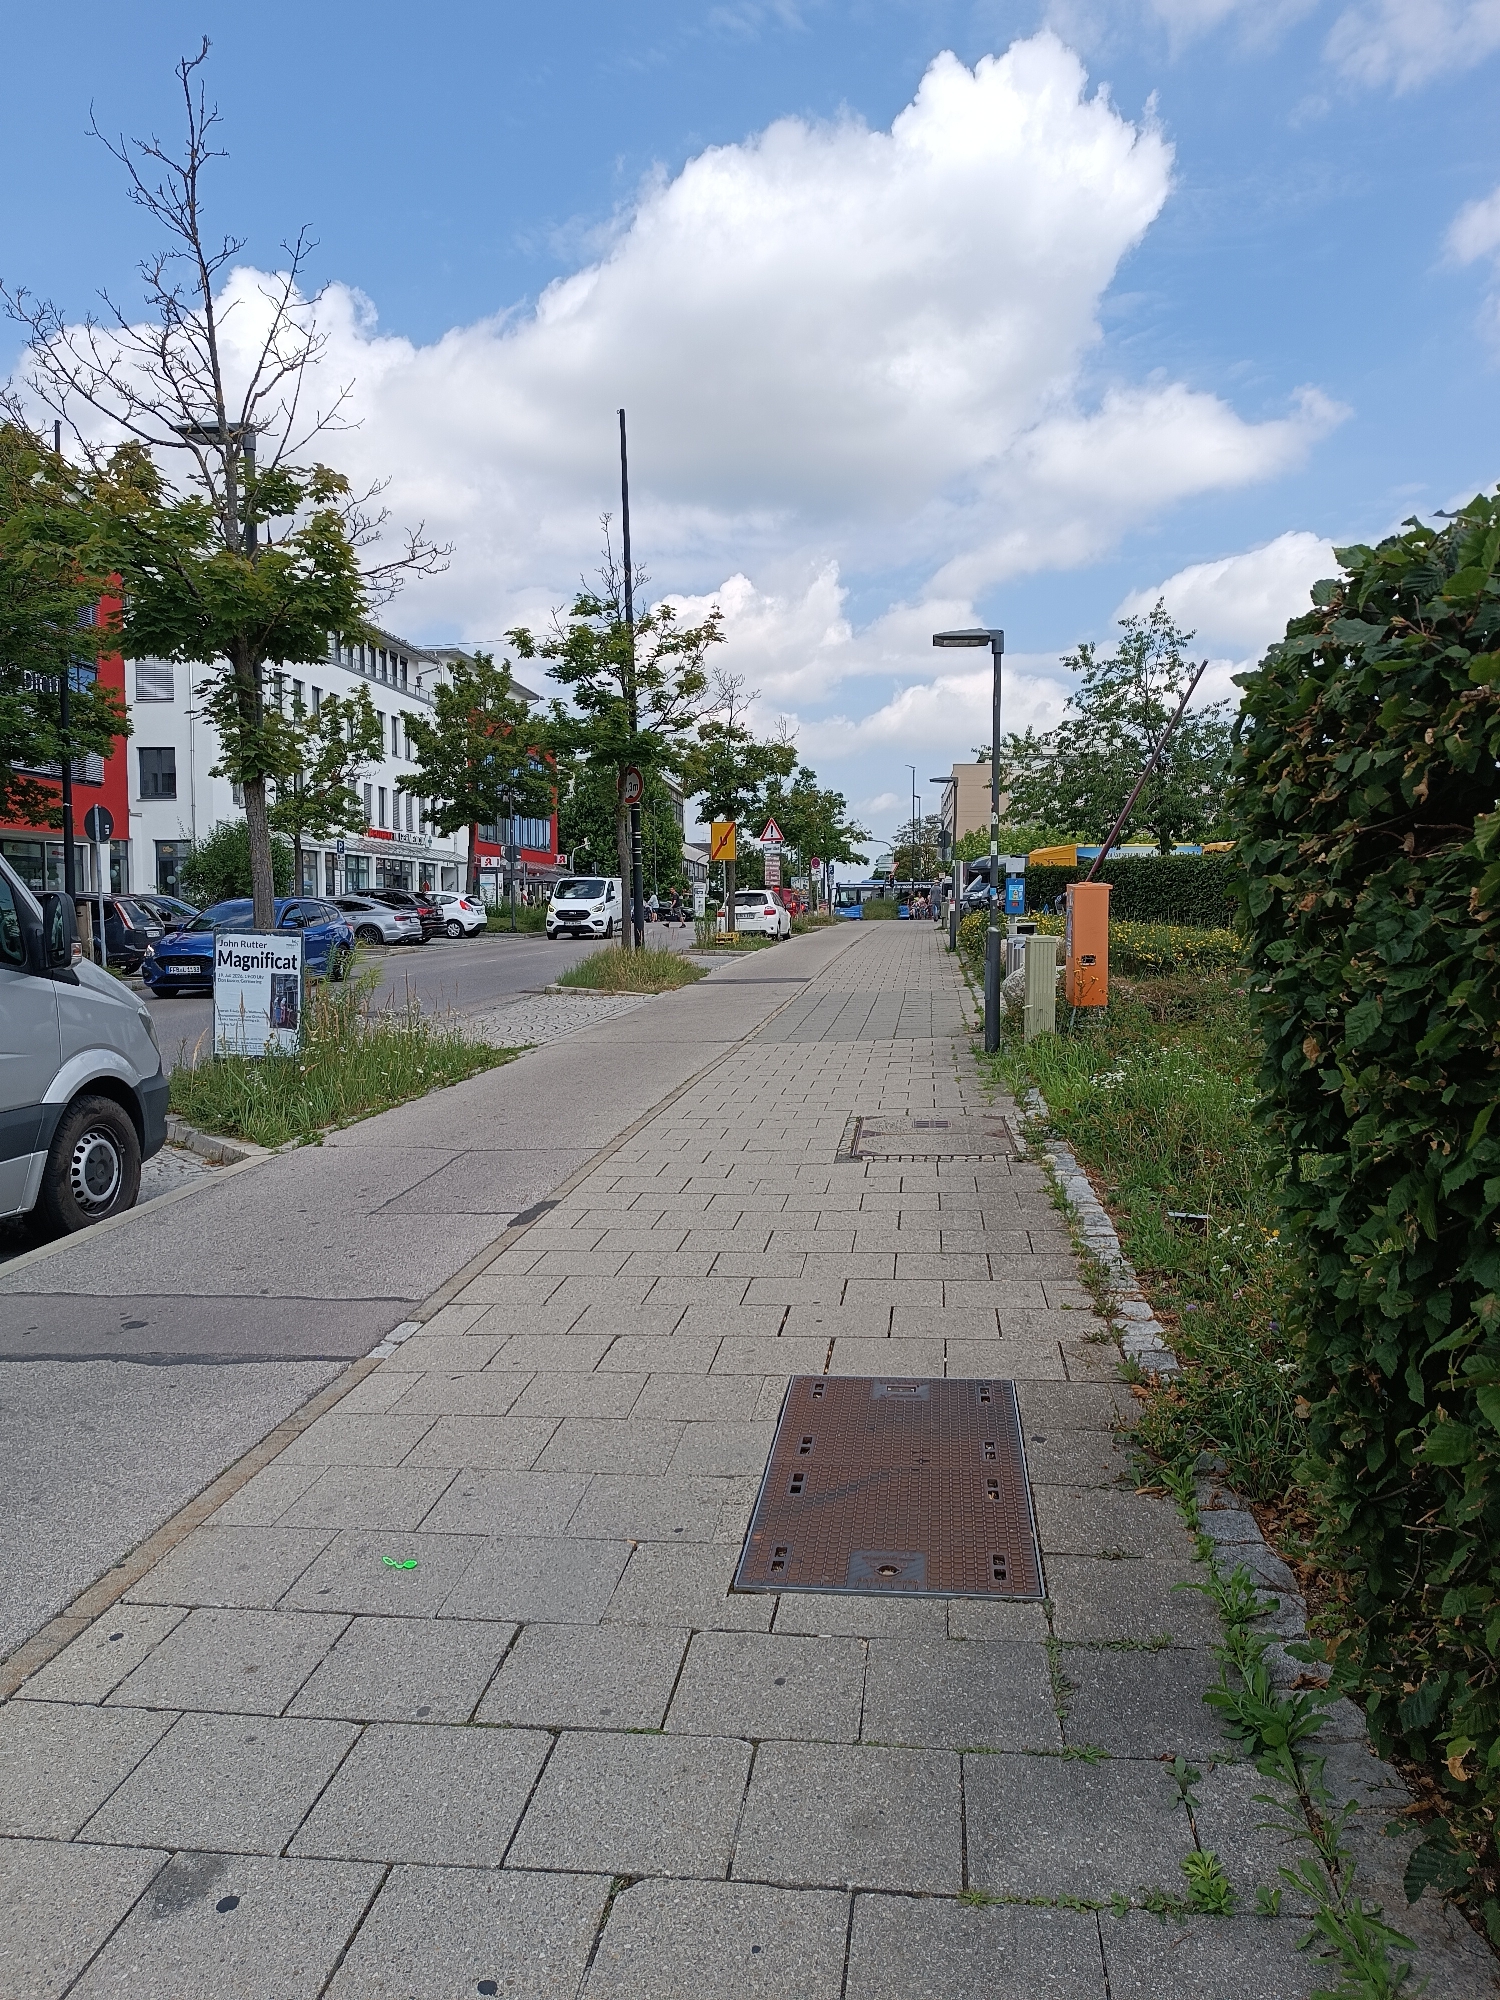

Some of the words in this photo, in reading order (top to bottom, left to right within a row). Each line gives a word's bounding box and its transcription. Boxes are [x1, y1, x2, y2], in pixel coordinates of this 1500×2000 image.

[219, 939, 239, 948] John
[240, 941, 268, 949] Rutter
[217, 949, 298, 972] Magnificat
